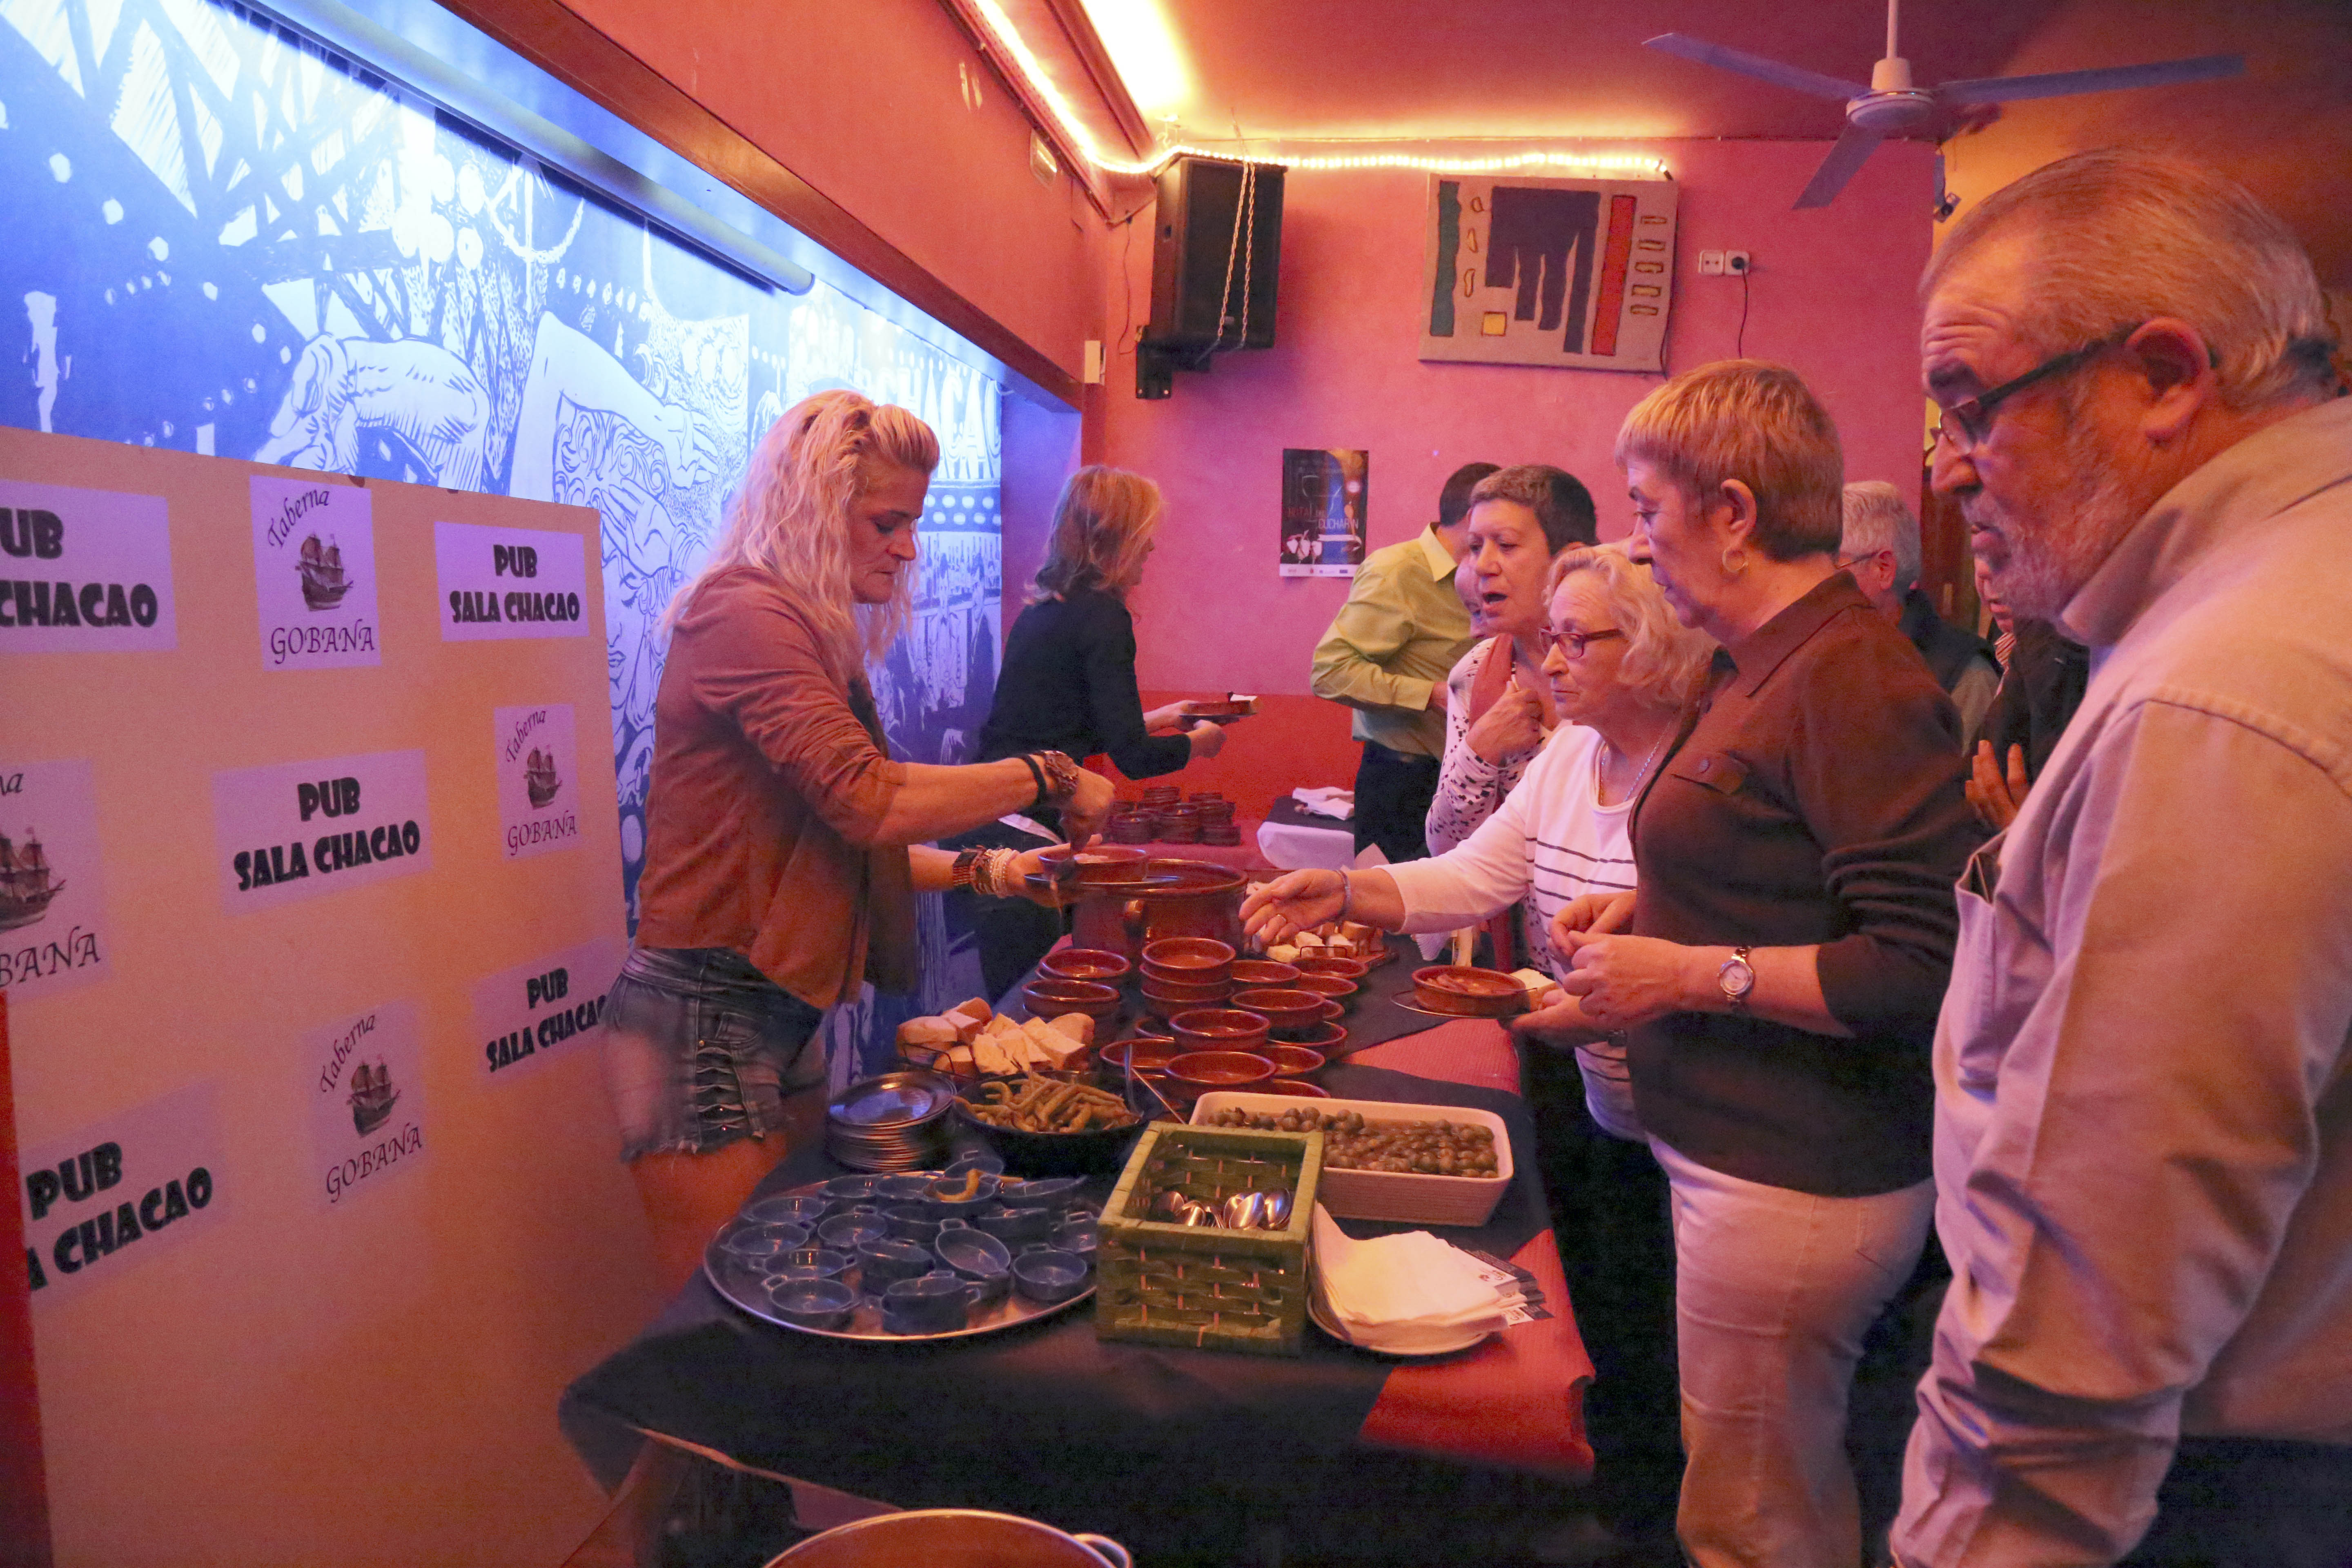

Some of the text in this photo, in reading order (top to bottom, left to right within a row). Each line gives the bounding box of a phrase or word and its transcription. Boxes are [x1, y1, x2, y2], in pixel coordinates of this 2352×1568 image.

[268, 489, 330, 548] Taberna
[493, 544, 537, 578] PUB
[450, 590, 580, 624] SALA CHACAO
[271, 619, 374, 664] GOBANA
[506, 710, 546, 763] Taberna
[297, 777, 361, 822] PUB
[234, 820, 420, 892] SALA CHACAO
[508, 810, 577, 856] GOBANA
[527, 967, 568, 1010] PUB
[320, 1014, 376, 1093] Taberna
[486, 1026, 535, 1073] SALA
[26, 1141, 123, 1221] PUB
[327, 1122, 422, 1203] GOBANA
[53, 1167, 213, 1274] CHACAO
